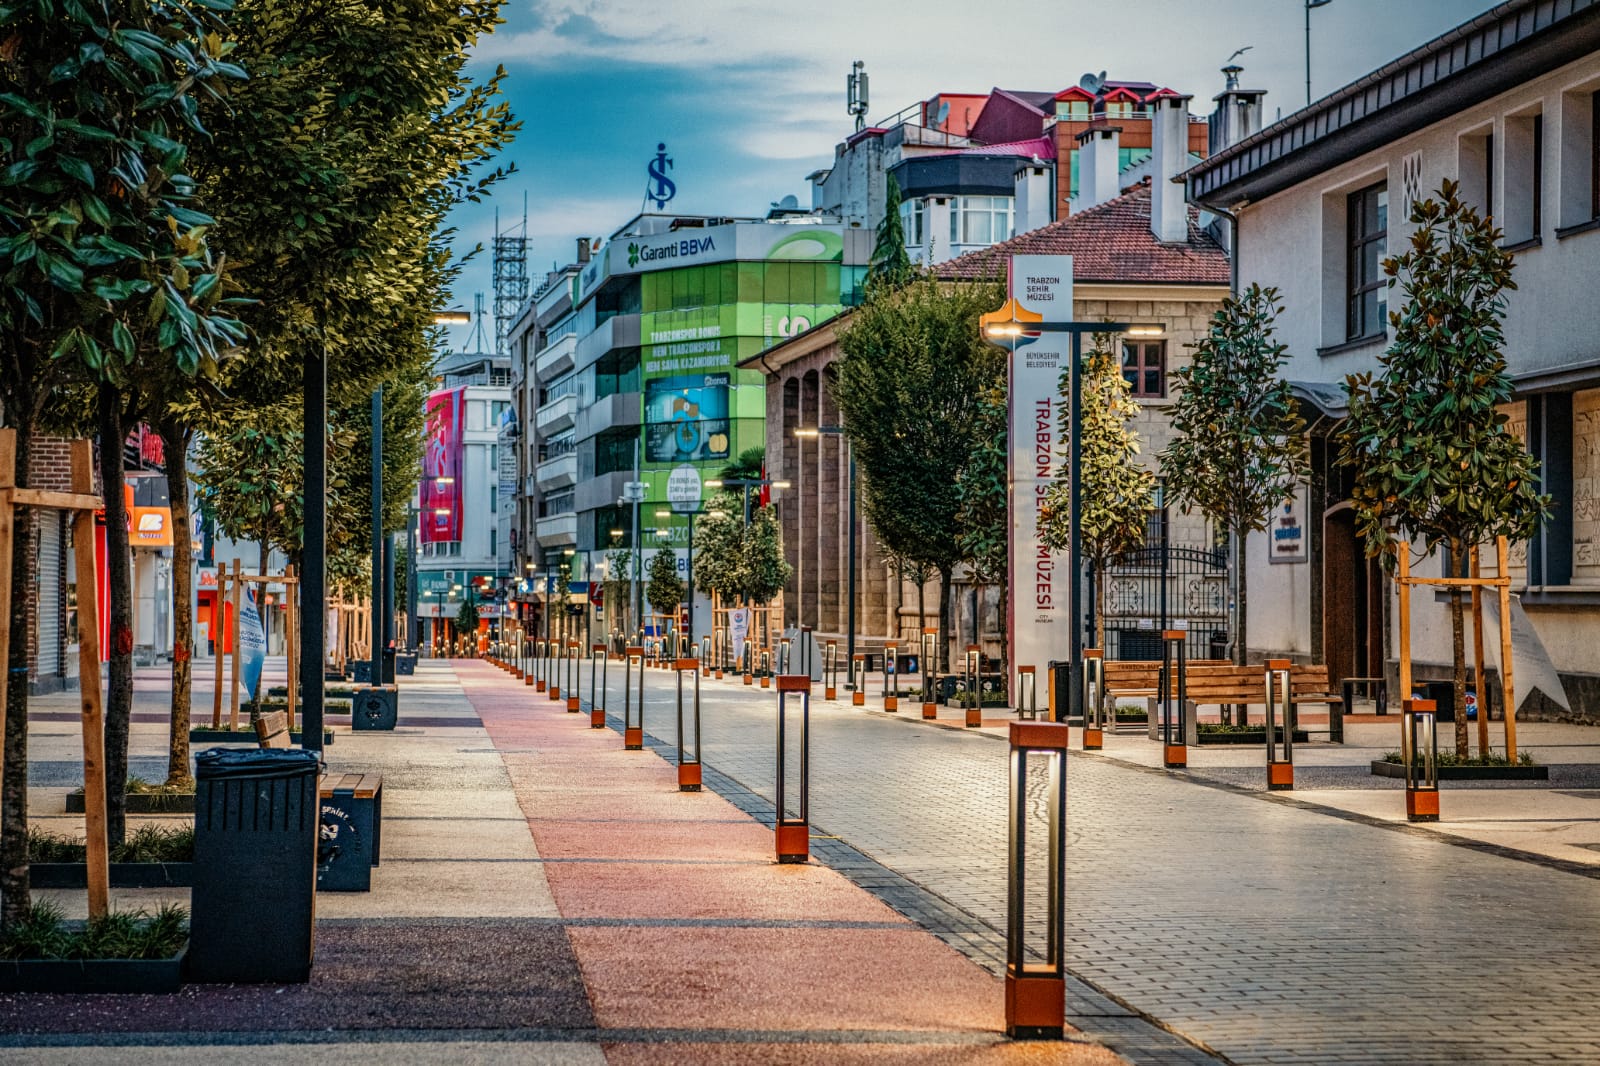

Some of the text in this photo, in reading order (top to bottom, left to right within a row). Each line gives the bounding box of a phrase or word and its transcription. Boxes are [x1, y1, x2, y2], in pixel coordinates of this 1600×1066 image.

[640, 236, 715, 261] Garanti BBVA
[1026, 276, 1060, 284] TRABZON
[1026, 292, 1054, 301] MÜZESİ
[650, 328, 697, 344] TRABZONSPOR
[646, 361, 660, 372] HEM
[1035, 397, 1054, 610] TRABZON ŞER MÜZESİ
[644, 526, 693, 542] TRABZO
